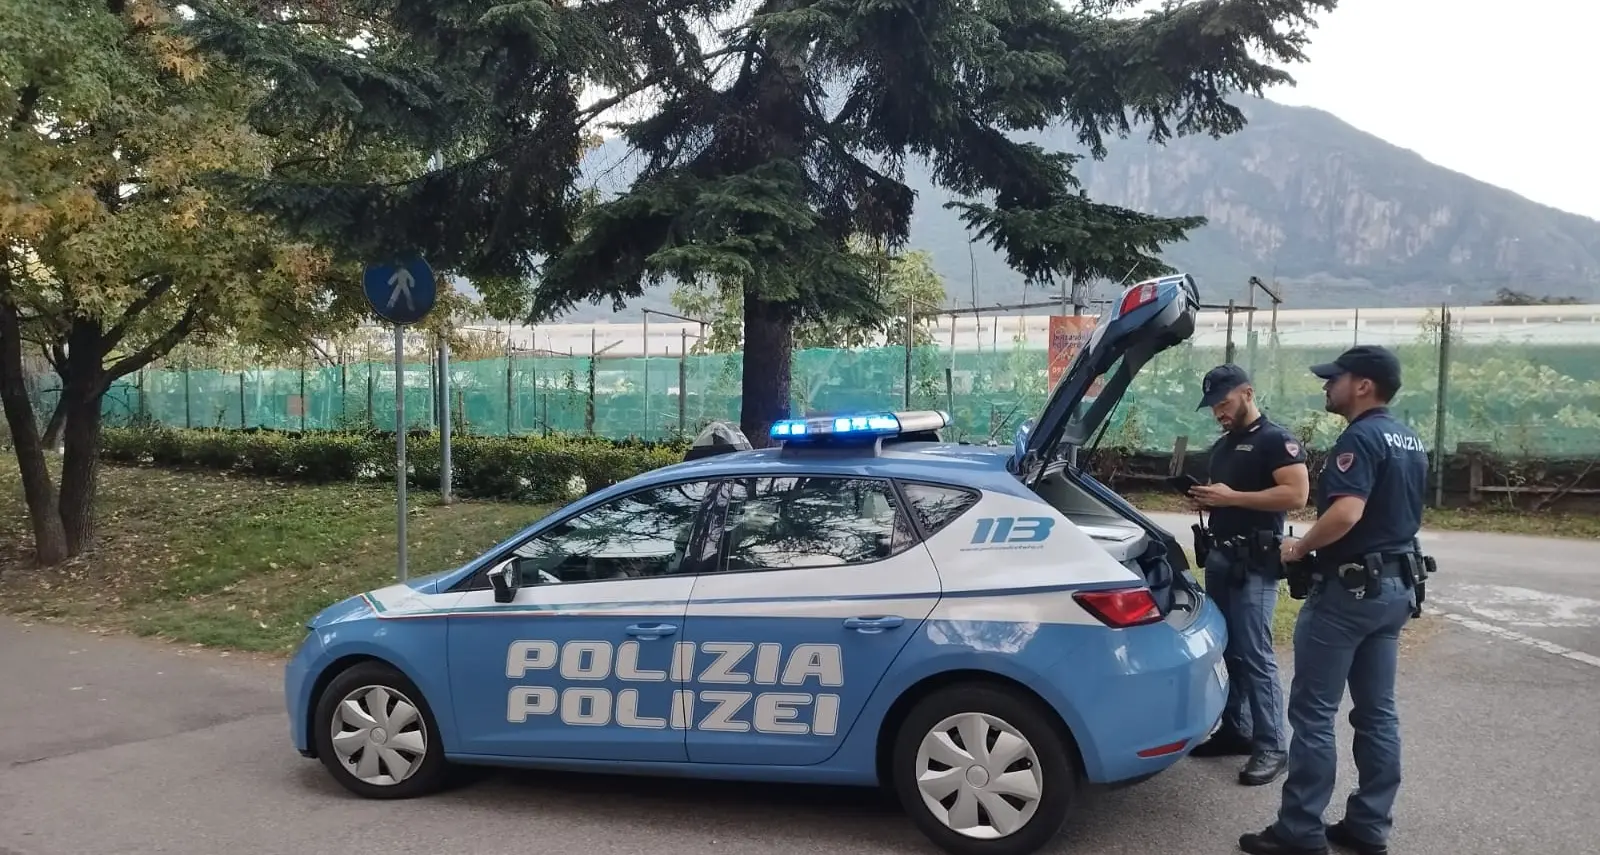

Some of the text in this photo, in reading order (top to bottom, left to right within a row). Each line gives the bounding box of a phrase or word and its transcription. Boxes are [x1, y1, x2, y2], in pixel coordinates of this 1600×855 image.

[1384, 432, 1425, 453] POLIZIA
[970, 516, 1056, 544] 113
[505, 640, 844, 687] POLIZIA
[507, 686, 841, 736] POLIZEI
